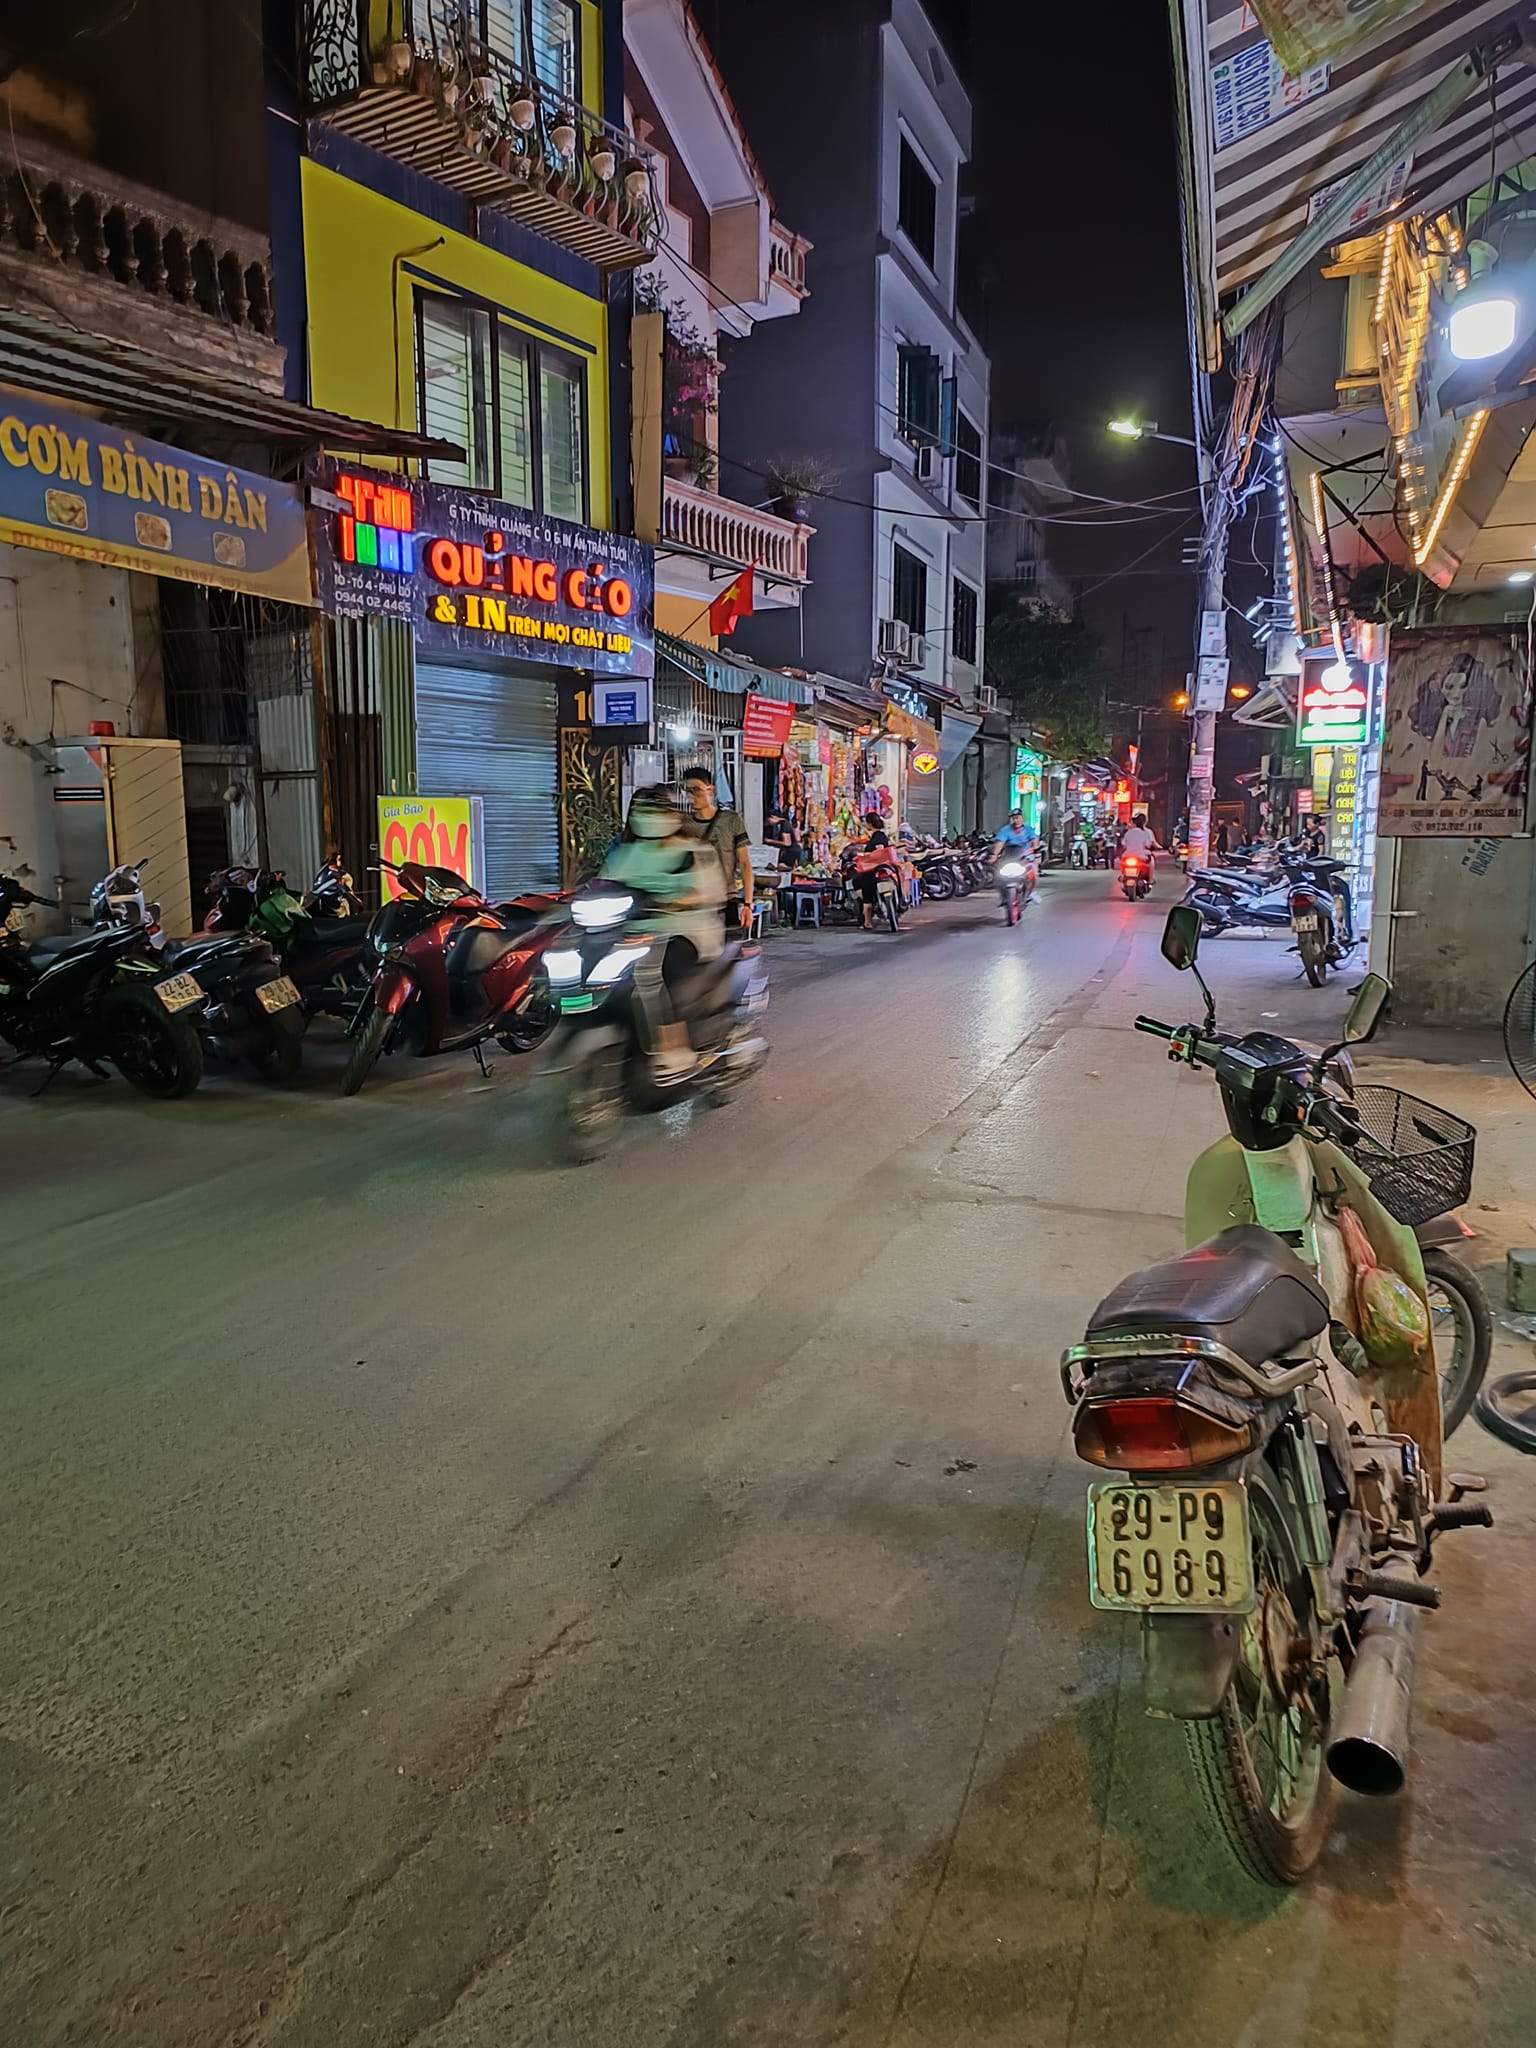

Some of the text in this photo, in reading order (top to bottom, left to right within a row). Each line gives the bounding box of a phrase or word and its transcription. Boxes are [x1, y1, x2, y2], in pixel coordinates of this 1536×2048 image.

[0, 416, 268, 533] CƠM BÌNH DÂN
[459, 507, 472, 522] TY
[472, 510, 498, 529] TNHH
[562, 533, 571, 547] IN
[335, 590, 364, 606] 0944
[366, 596, 381, 608] 02
[434, 594, 456, 624] &
[464, 594, 507, 632] IN
[508, 615, 542, 639] TRÊN
[544, 620, 570, 644] MỌI
[574, 691, 592, 720] 1
[383, 805, 400, 818] Gia
[1111, 1492, 1224, 1541] 29-P9
[1113, 1548, 1227, 1598] 6989
